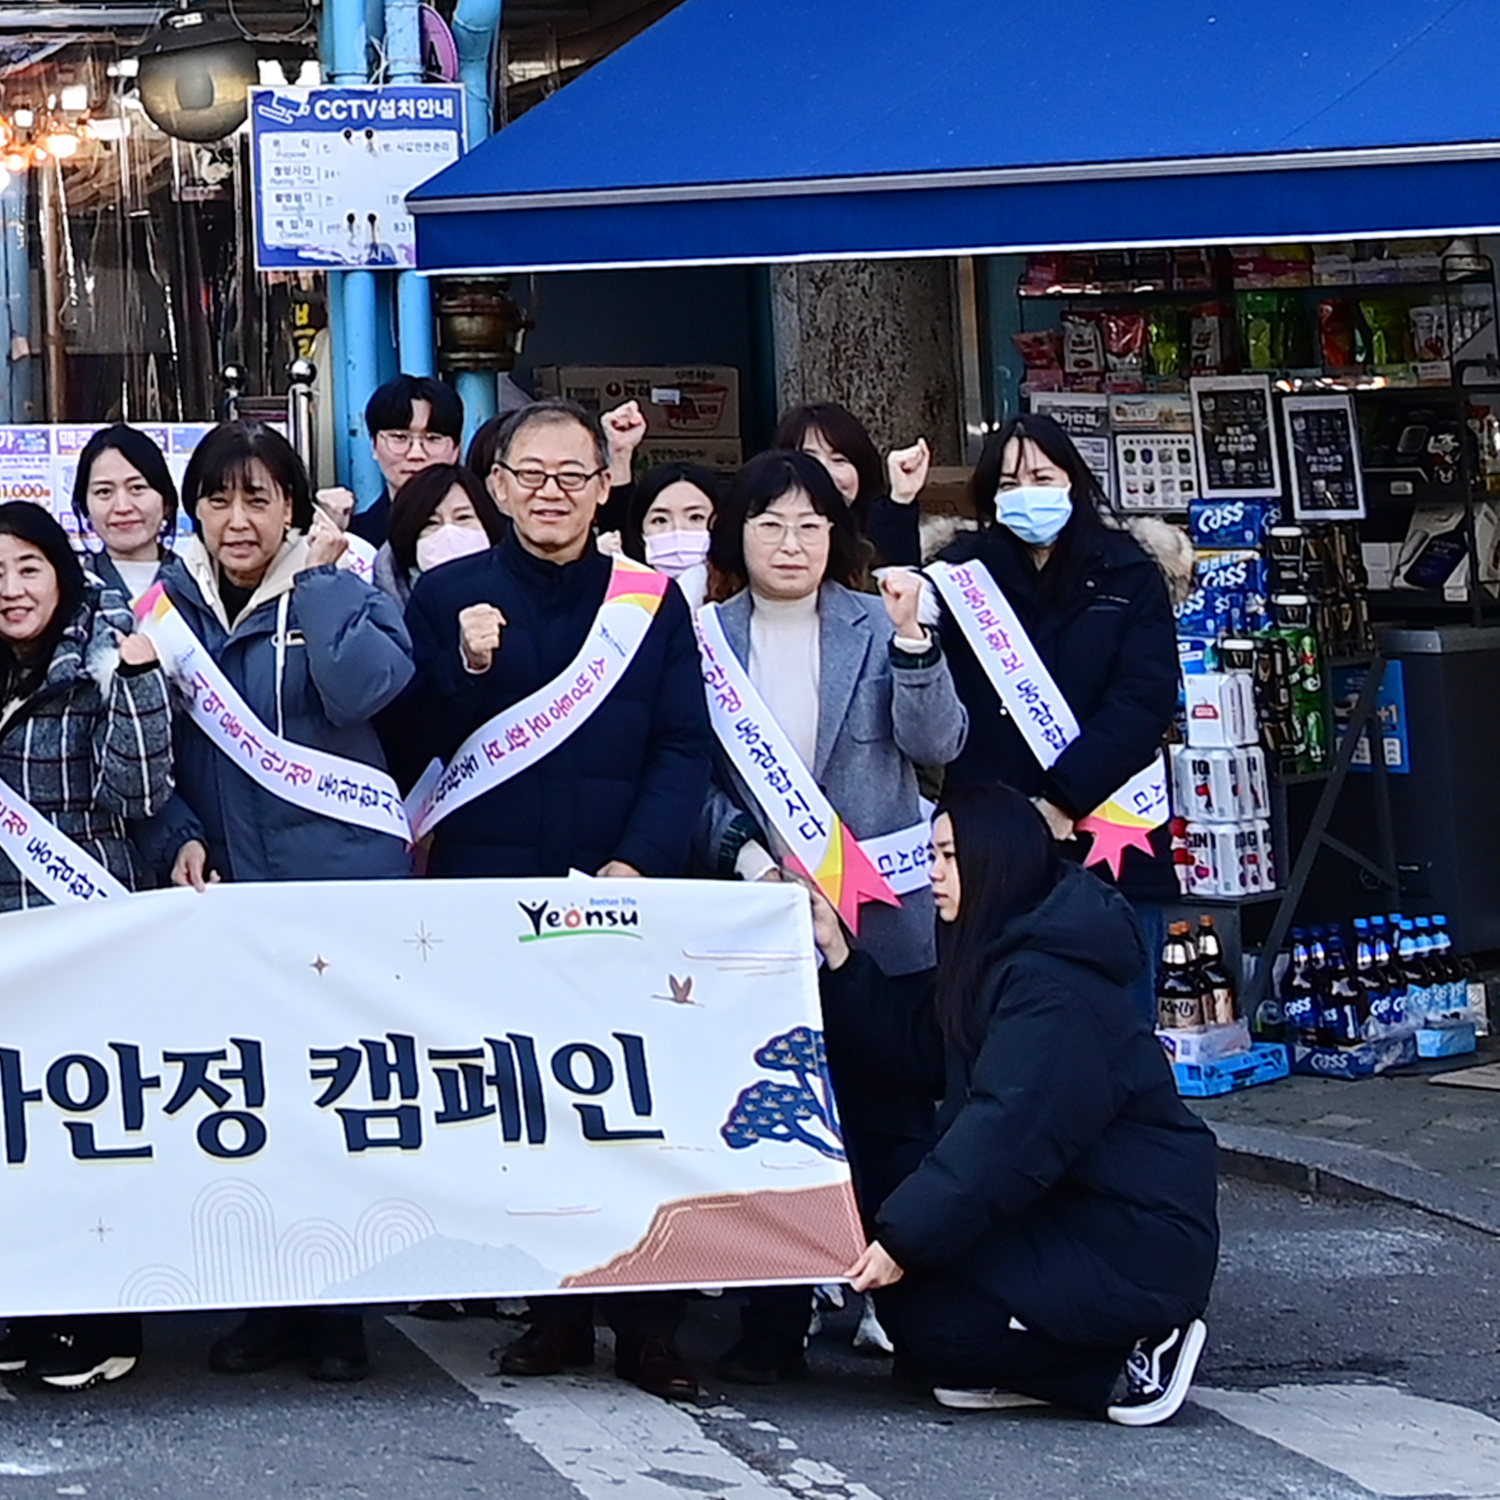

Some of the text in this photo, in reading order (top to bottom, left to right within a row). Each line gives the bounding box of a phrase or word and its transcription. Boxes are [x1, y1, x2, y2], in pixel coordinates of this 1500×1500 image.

[314, 98, 454, 120] CCTV설치안내
[944, 561, 1025, 678] 방통로확보
[482, 657, 606, 767] 소방통로확보
[734, 716, 827, 841] 동참합시다
[517, 898, 639, 938] Yeonsu
[1159, 999, 1196, 1018] Kelly
[310, 1030, 666, 1153] 캠페인
